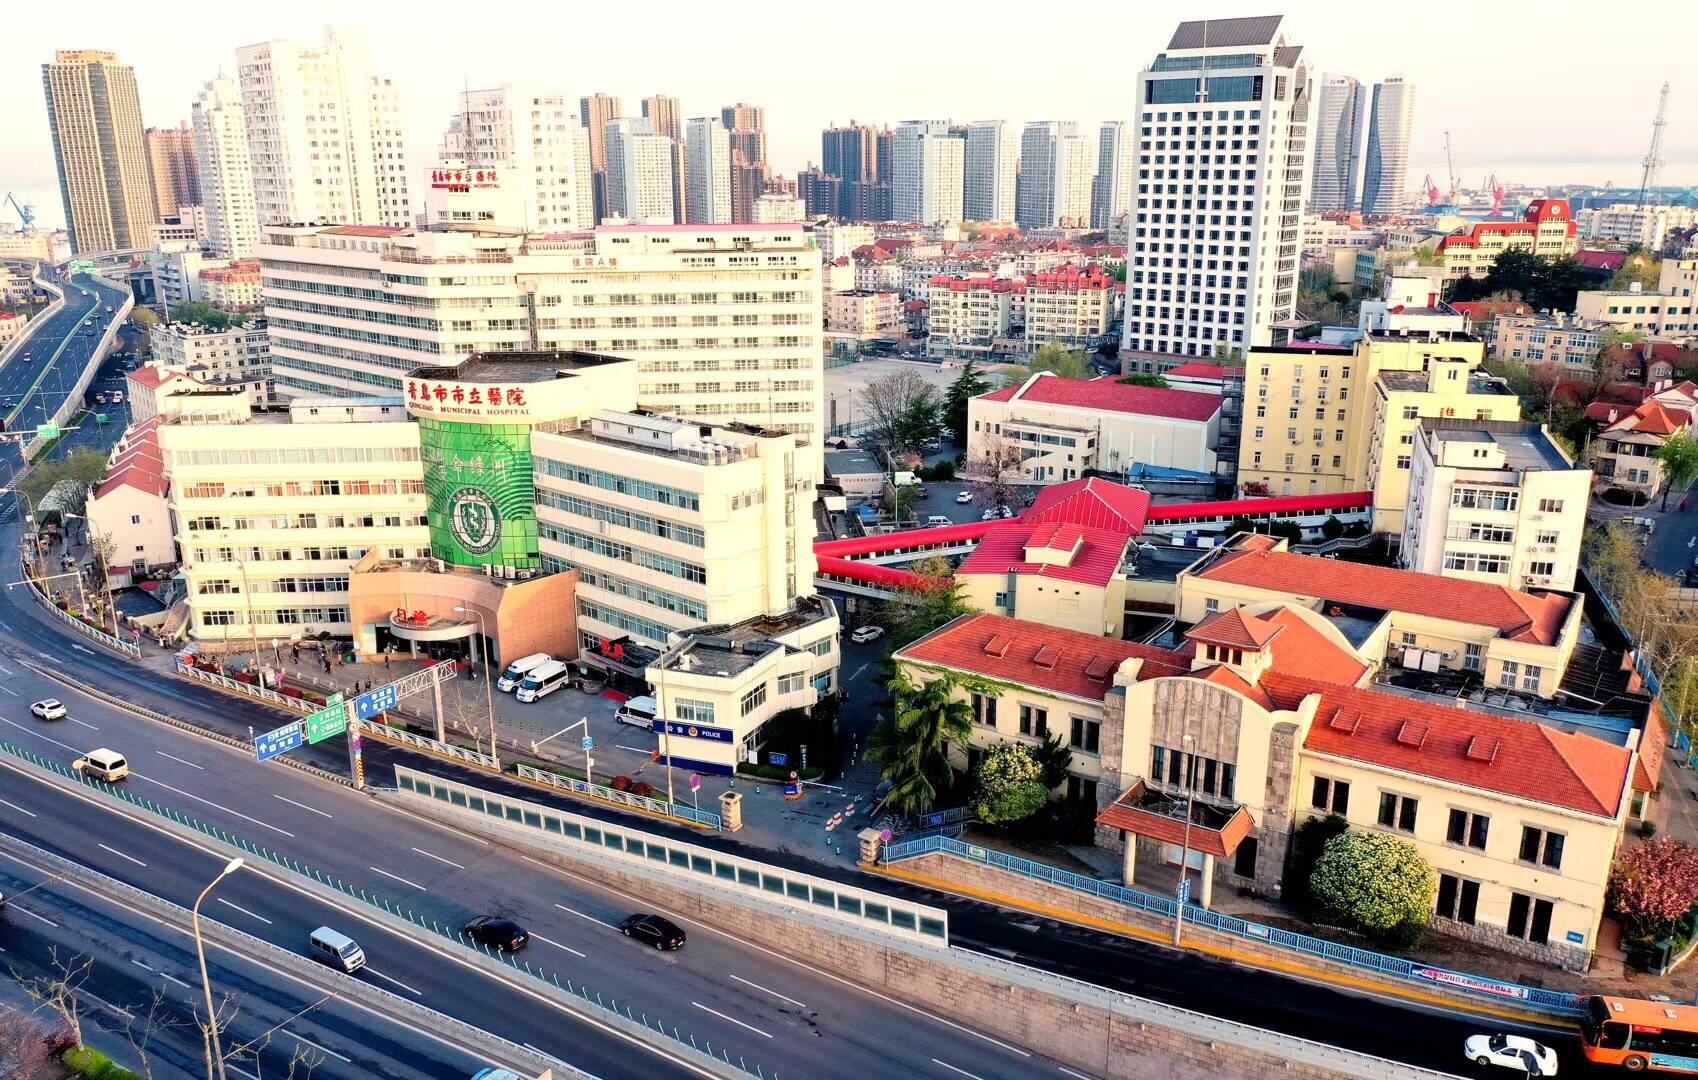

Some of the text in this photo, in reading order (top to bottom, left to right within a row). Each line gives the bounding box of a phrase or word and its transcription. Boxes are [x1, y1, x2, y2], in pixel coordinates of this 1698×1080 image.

[408, 402, 433, 411] QINGDAO
[440, 406, 481, 415] MUNICIPAL
[701, 730, 721, 738] POLICE
